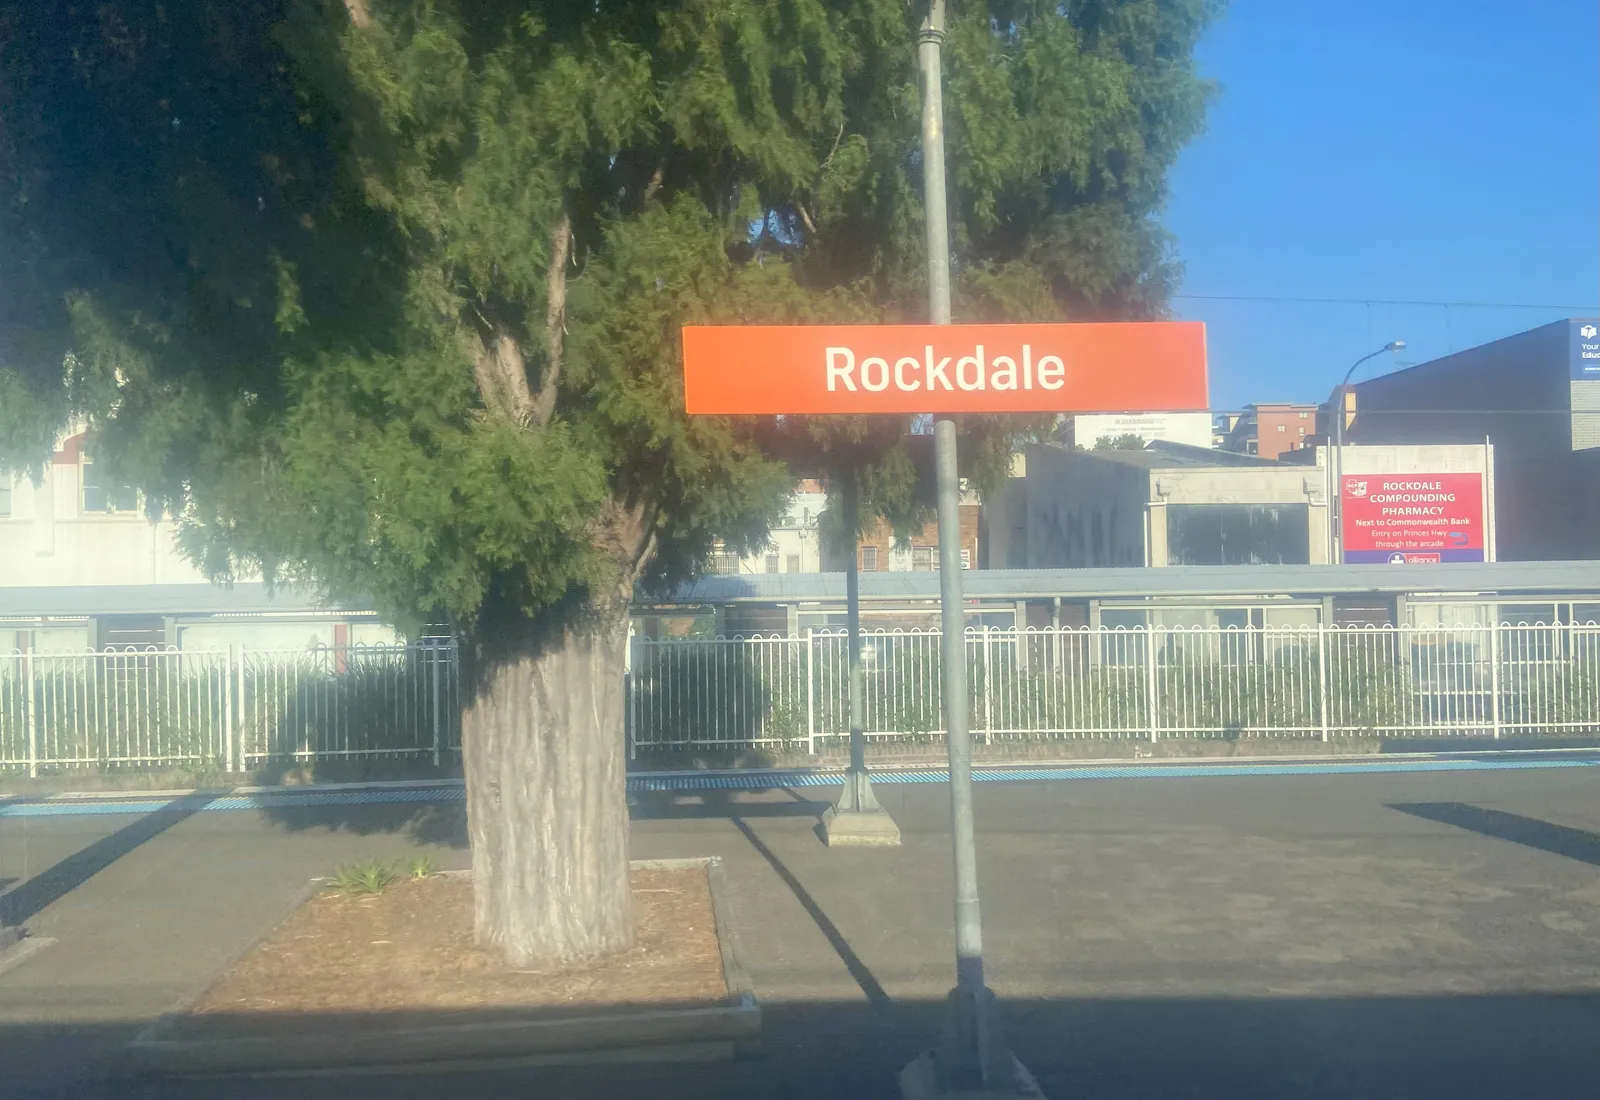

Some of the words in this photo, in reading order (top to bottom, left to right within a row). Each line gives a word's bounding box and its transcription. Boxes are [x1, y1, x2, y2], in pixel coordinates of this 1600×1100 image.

[825, 344, 1065, 392] Rockdale
[1383, 482, 1442, 490] ROCKDALE
[1369, 494, 1456, 502] COMPOUNDING
[1382, 507, 1444, 515] PHARMACY
[1355, 519, 1375, 527] Next
[1386, 518, 1449, 526] Commonwealth
[1371, 530, 1391, 538] Entry
[1403, 529, 1430, 537] Princes
[1431, 529, 1448, 538] Hwy
[1375, 540, 1405, 548] through
